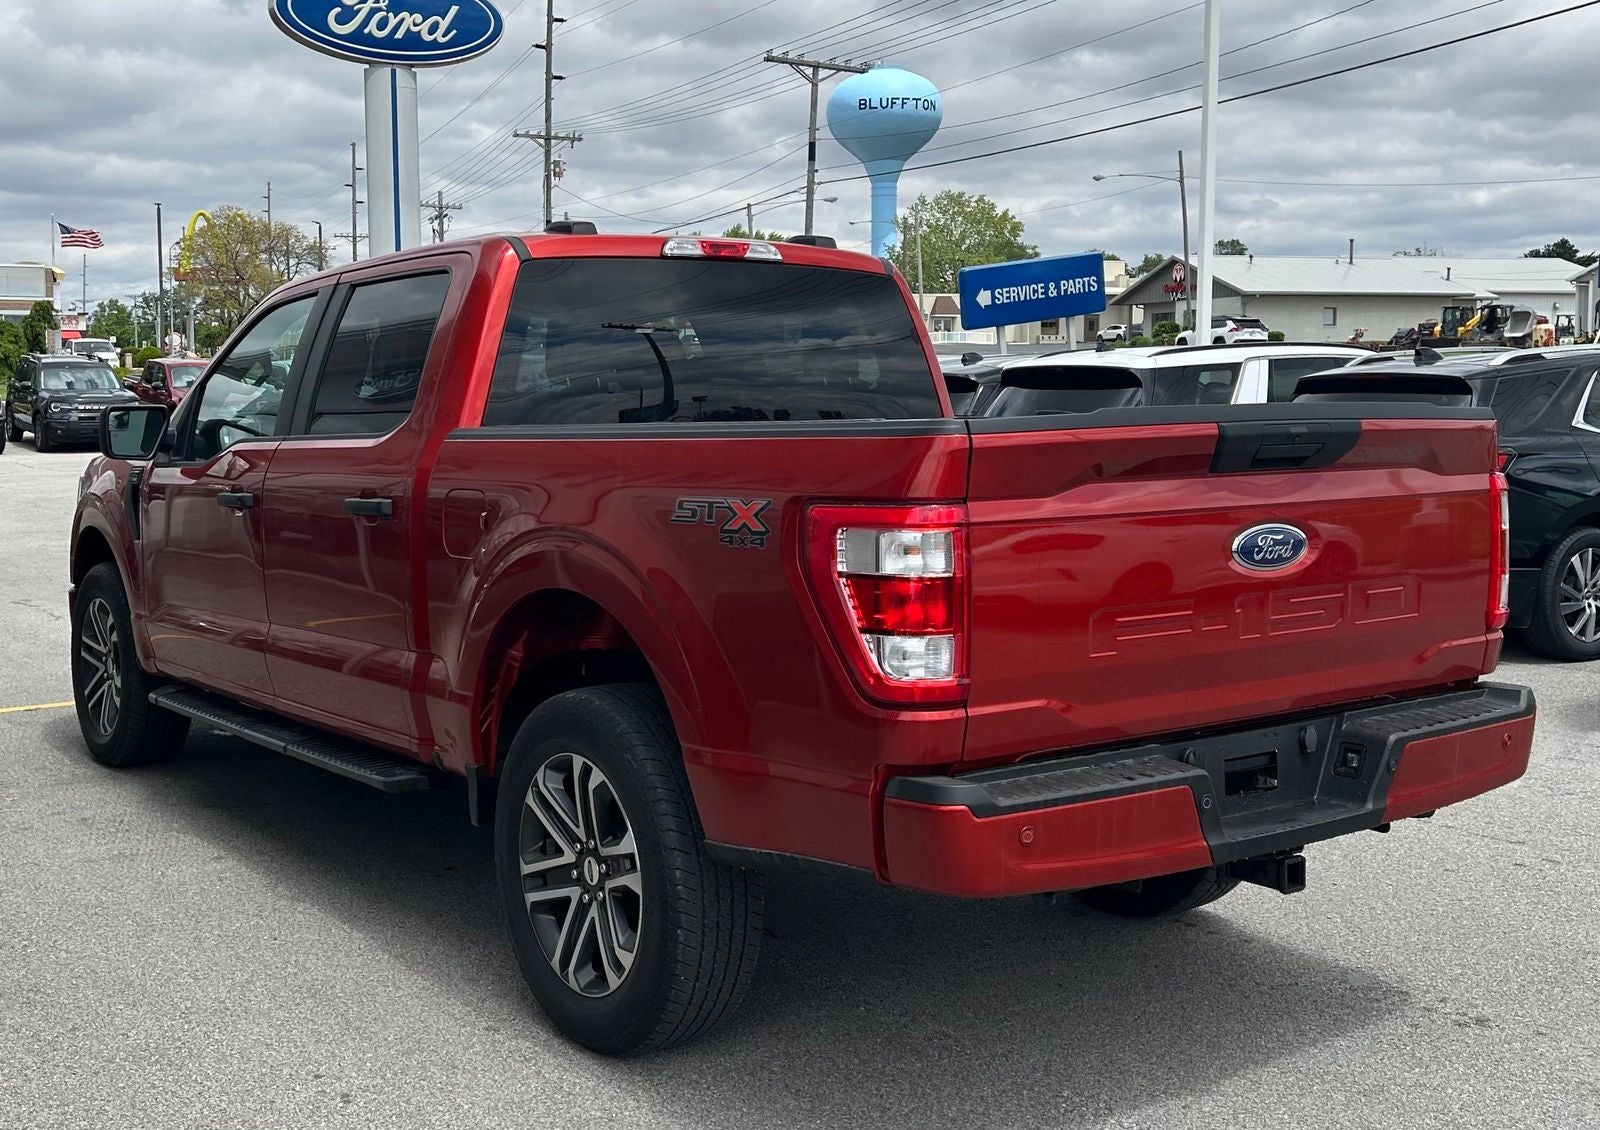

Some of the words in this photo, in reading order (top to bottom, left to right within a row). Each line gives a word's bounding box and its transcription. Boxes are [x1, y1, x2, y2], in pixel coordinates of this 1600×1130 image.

[327, 0, 459, 43] Ford
[858, 97, 936, 112] BLUFFTON
[994, 284, 1046, 304] SERVICE
[1048, 282, 1058, 297] &
[1060, 276, 1098, 296] PARTS
[669, 495, 773, 536] STX
[1253, 534, 1295, 561] Ford
[1089, 575, 1423, 658] F-150
